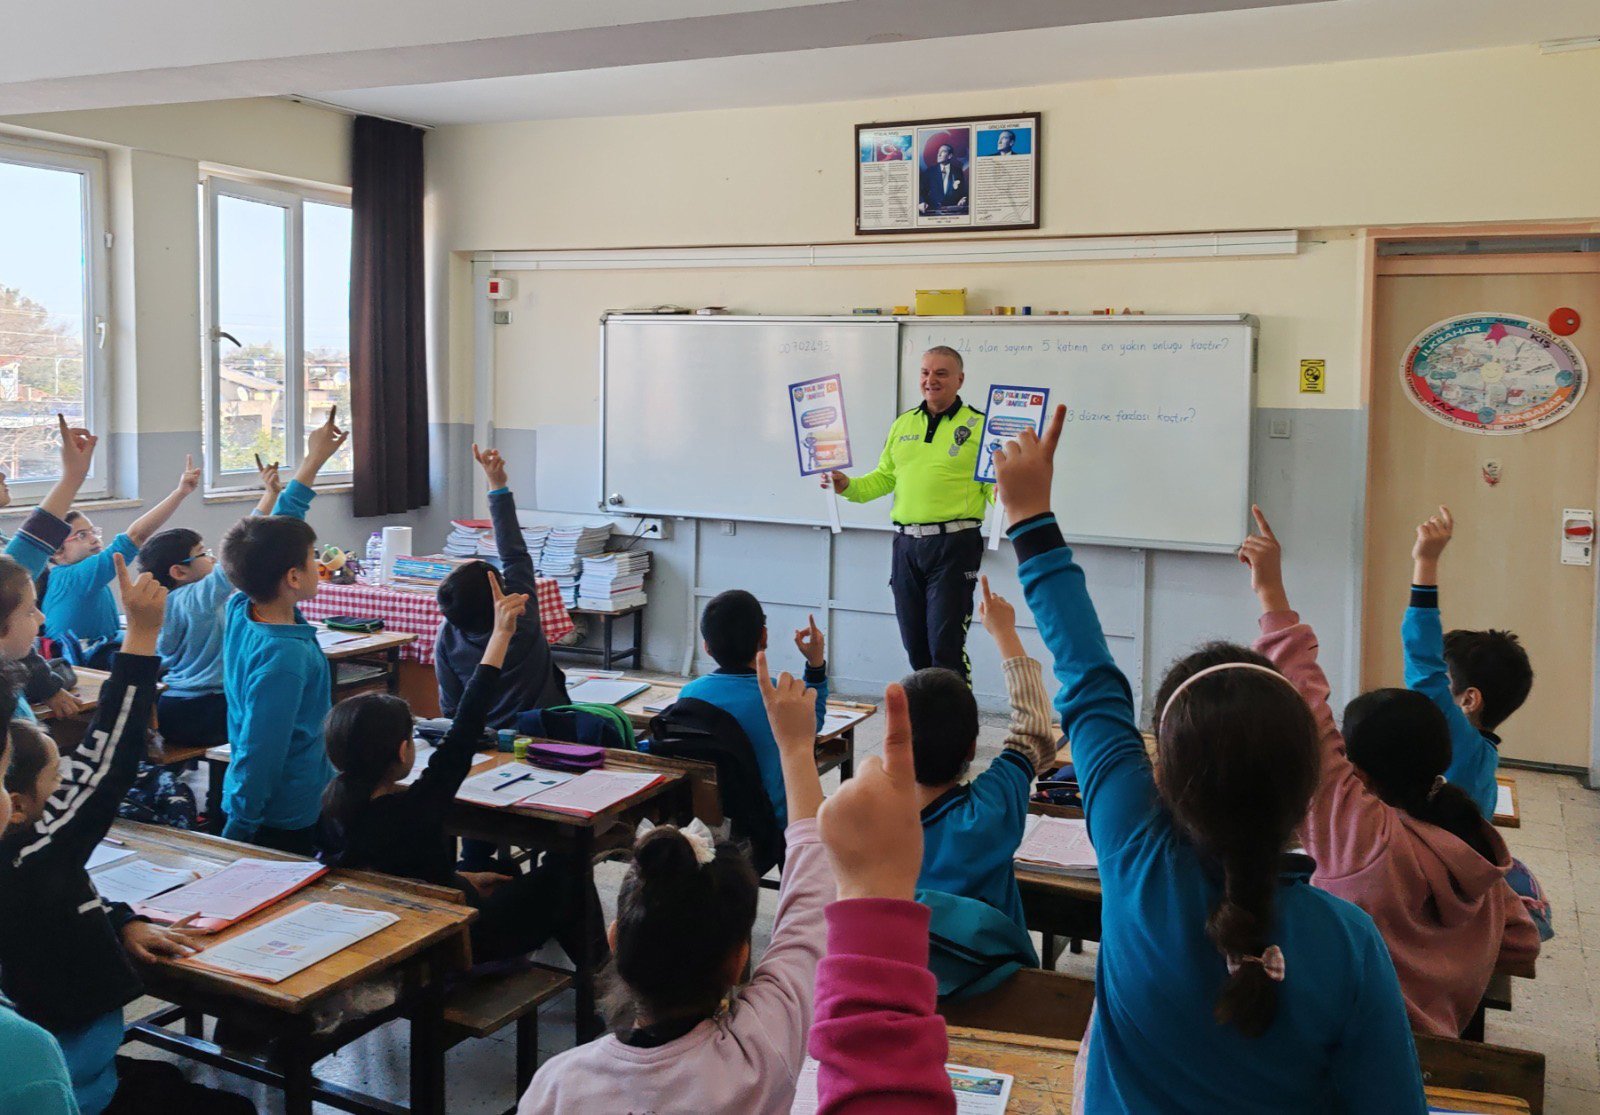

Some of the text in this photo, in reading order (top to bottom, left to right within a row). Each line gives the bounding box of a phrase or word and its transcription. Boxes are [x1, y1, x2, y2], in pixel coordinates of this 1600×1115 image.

[1040, 339, 1051, 352] 5
[1101, 343, 1113, 352] en
[1530, 333, 1551, 349] KIŞ
[1432, 396, 1455, 415] YAZ
[1067, 409, 1075, 423] 3
